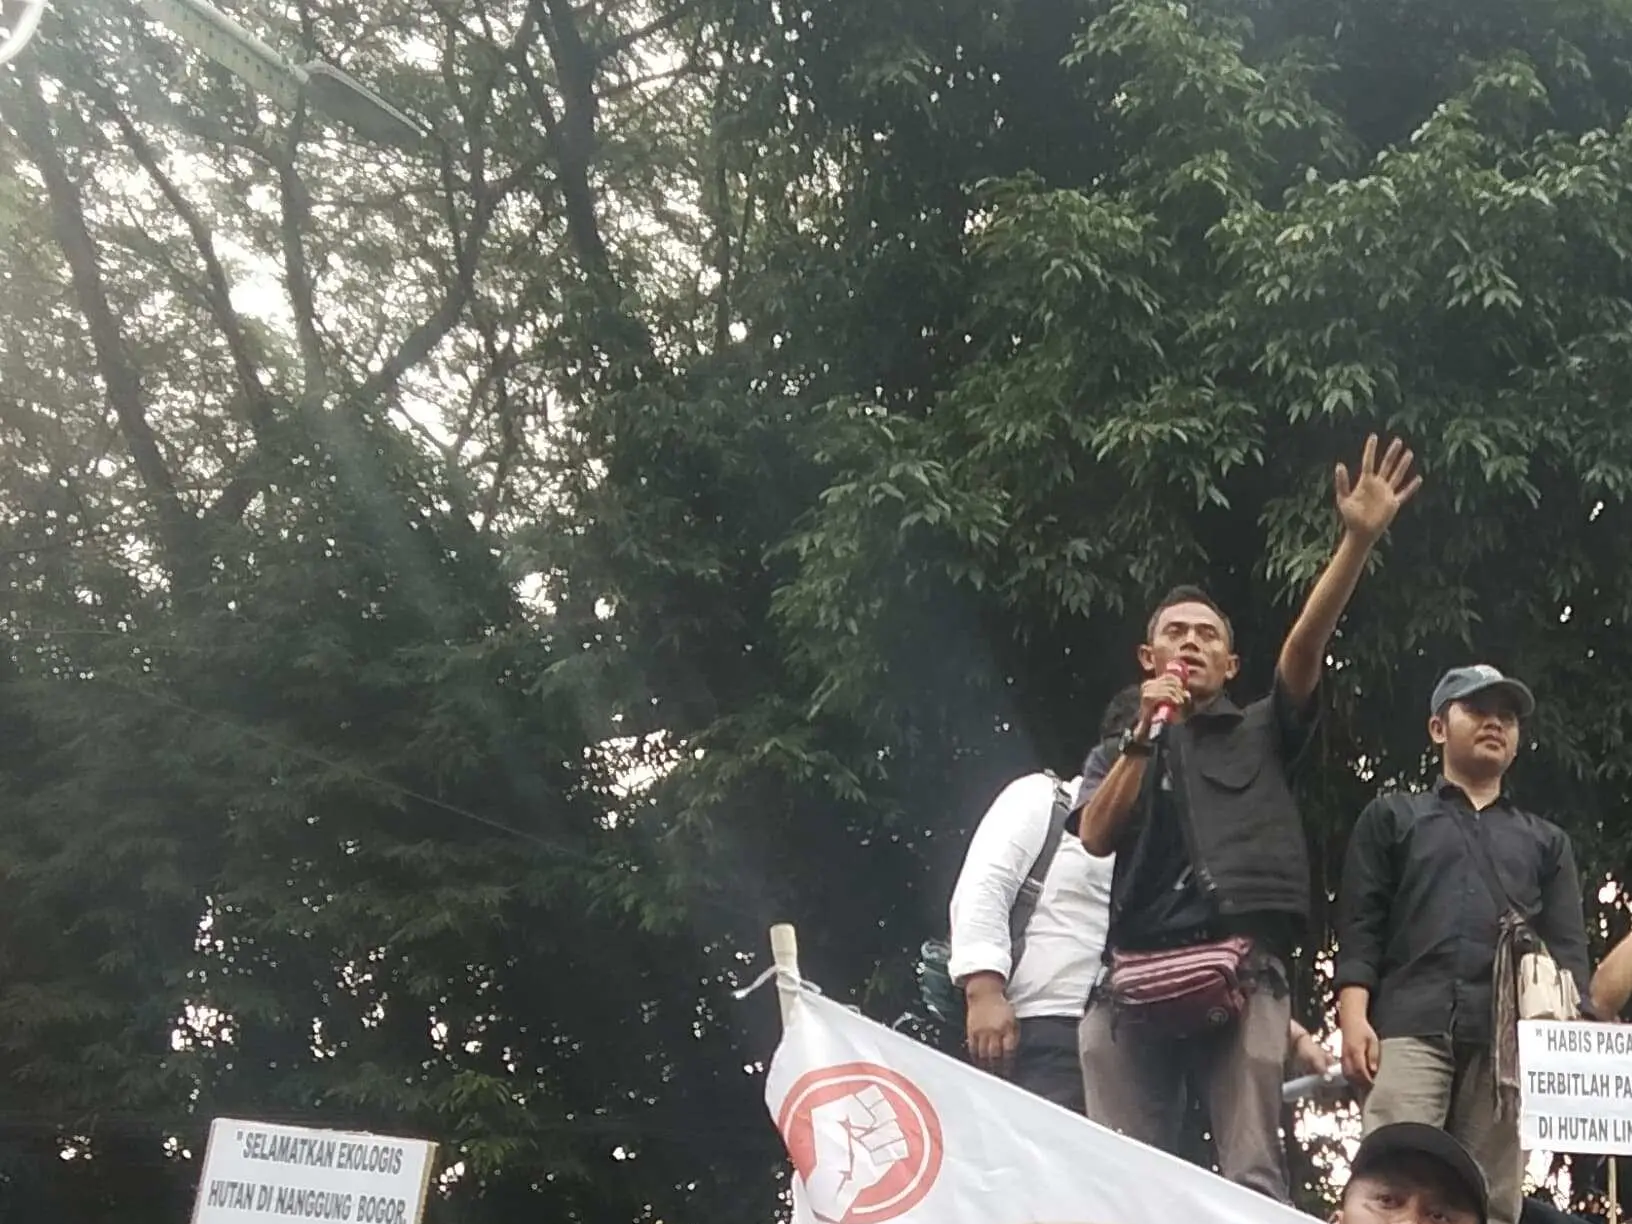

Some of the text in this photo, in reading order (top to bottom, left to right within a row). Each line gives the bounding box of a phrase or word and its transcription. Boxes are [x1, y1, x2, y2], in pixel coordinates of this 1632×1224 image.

[1548, 1029, 1592, 1053] HABIS
[1528, 1071, 1610, 1098] TERBITLAH
[1538, 1116, 1553, 1139] DI
[1558, 1117, 1608, 1142] HUTAN
[243, 1132, 334, 1167] SELAMATKAN
[337, 1143, 403, 1175] EKOLOGIS
[208, 1180, 253, 1210] HUTAN
[256, 1185, 274, 1212] DI
[275, 1187, 351, 1220] NANGGUNG
